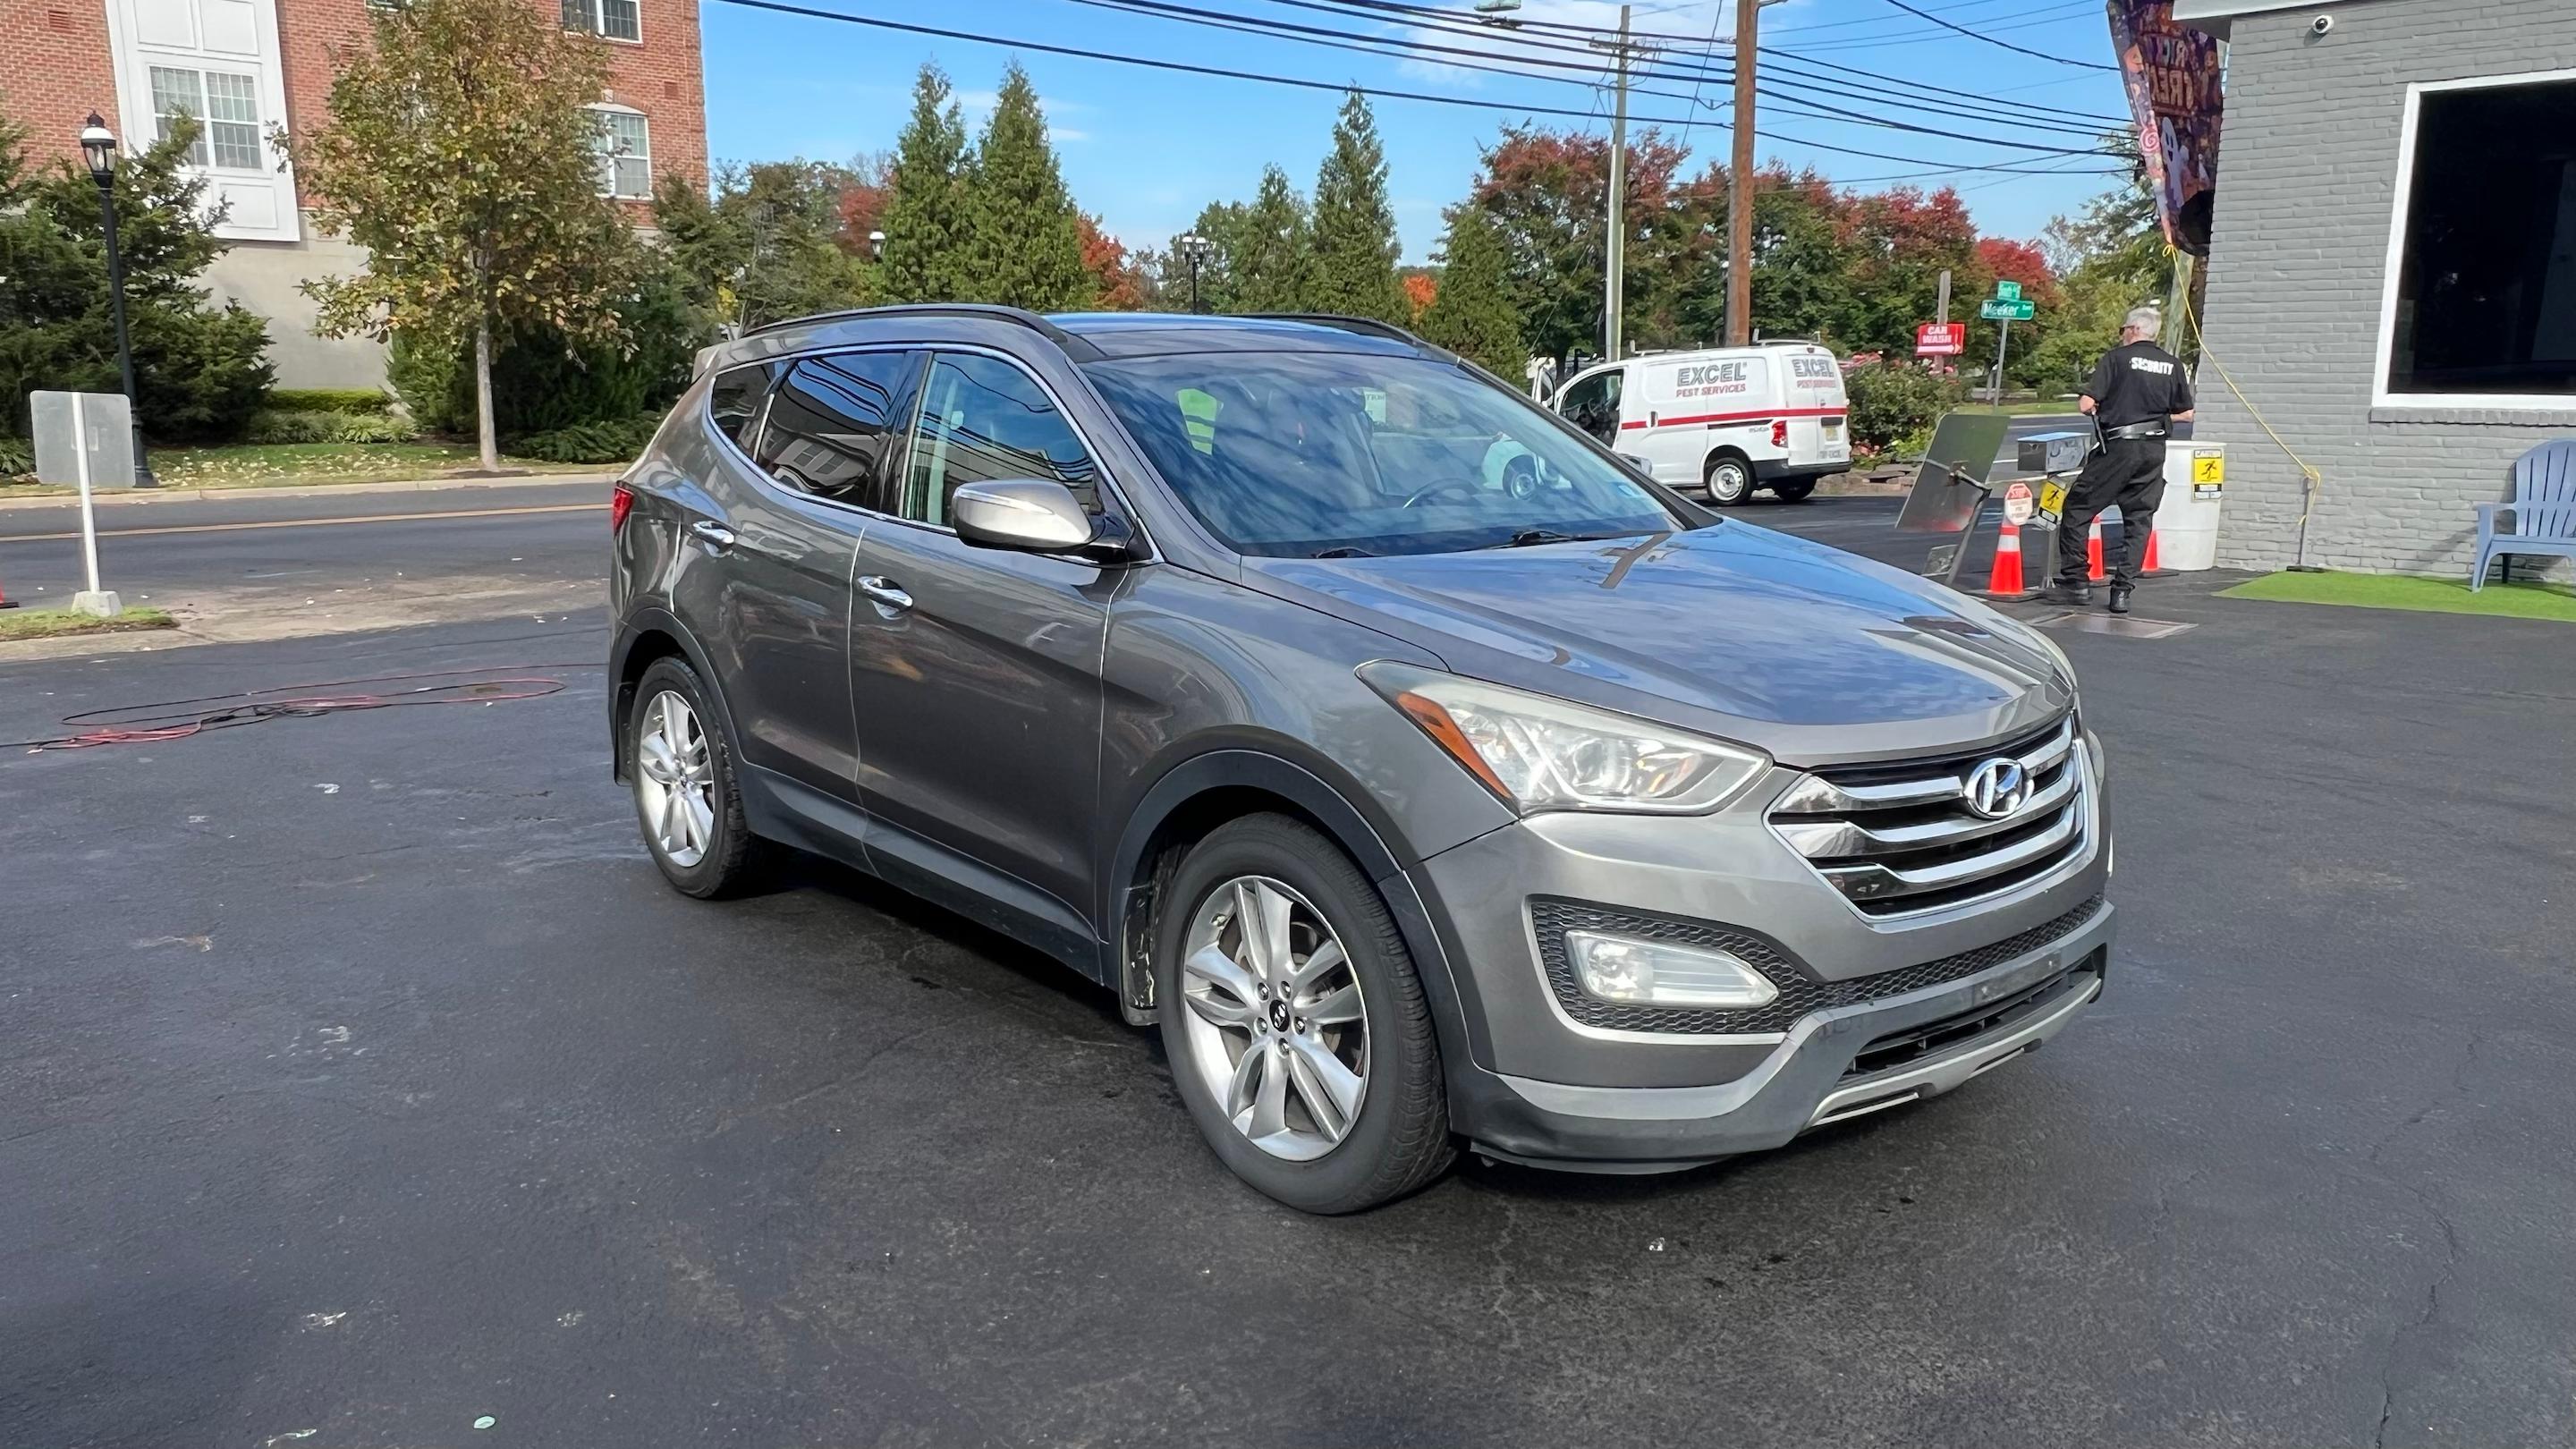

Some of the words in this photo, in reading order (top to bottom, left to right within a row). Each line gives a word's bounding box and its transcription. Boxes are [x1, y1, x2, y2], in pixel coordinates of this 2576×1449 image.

[1922, 335, 1952, 343] WASH
[1677, 362, 1746, 386] EXCEL
[1792, 359, 1835, 377] EXCEL
[2131, 356, 2174, 376] SECURITY
[1676, 387, 1699, 398] PEST
[1701, 383, 1746, 396] SERVICES
